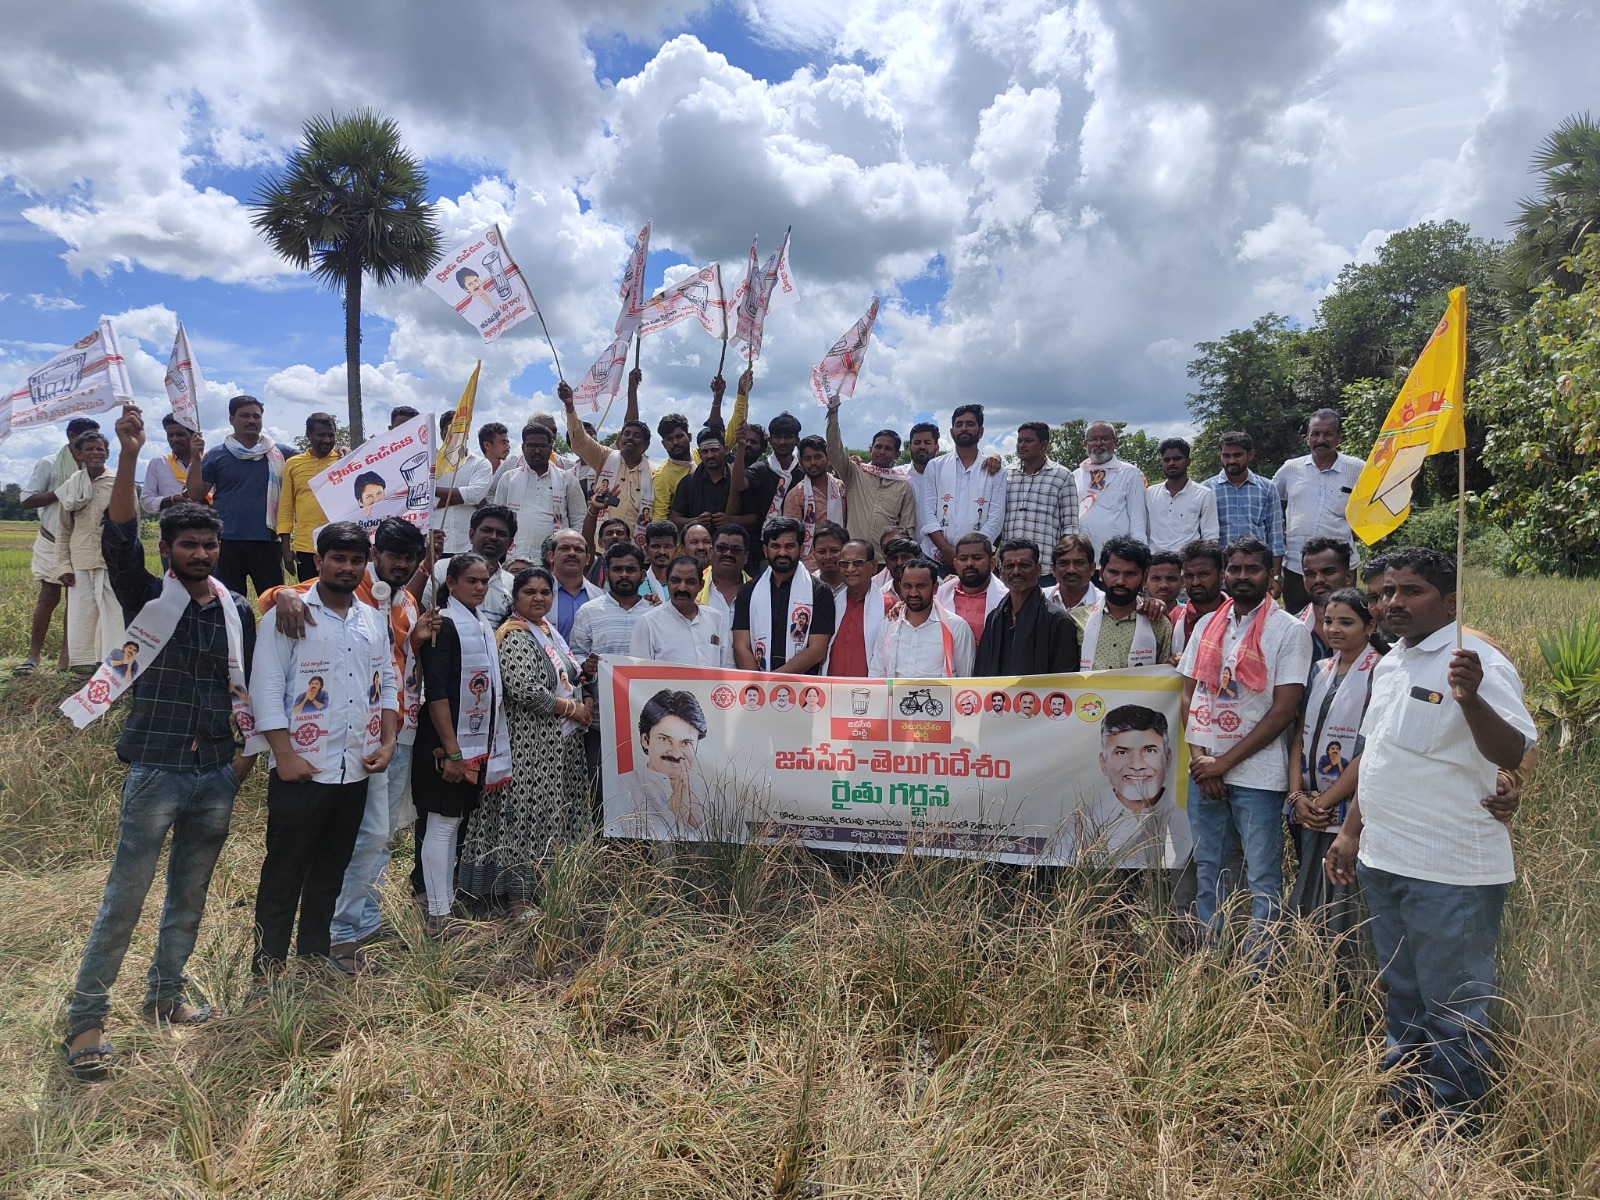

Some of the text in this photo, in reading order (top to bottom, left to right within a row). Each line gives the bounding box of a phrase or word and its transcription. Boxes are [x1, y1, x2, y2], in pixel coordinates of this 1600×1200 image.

[848, 720, 872, 728] జనసేన
[902, 722, 941, 731] తెలుగుదేశం
[851, 729, 868, 739] పార్టీ
[913, 731, 929, 741] పార్టీ
[775, 743, 1011, 779] జనసేన-తెలుగుదేశం
[831, 780, 950, 816] రైతు గర్జన
[779, 811, 805, 820] కోరలు
[839, 816, 864, 826] కరువు
